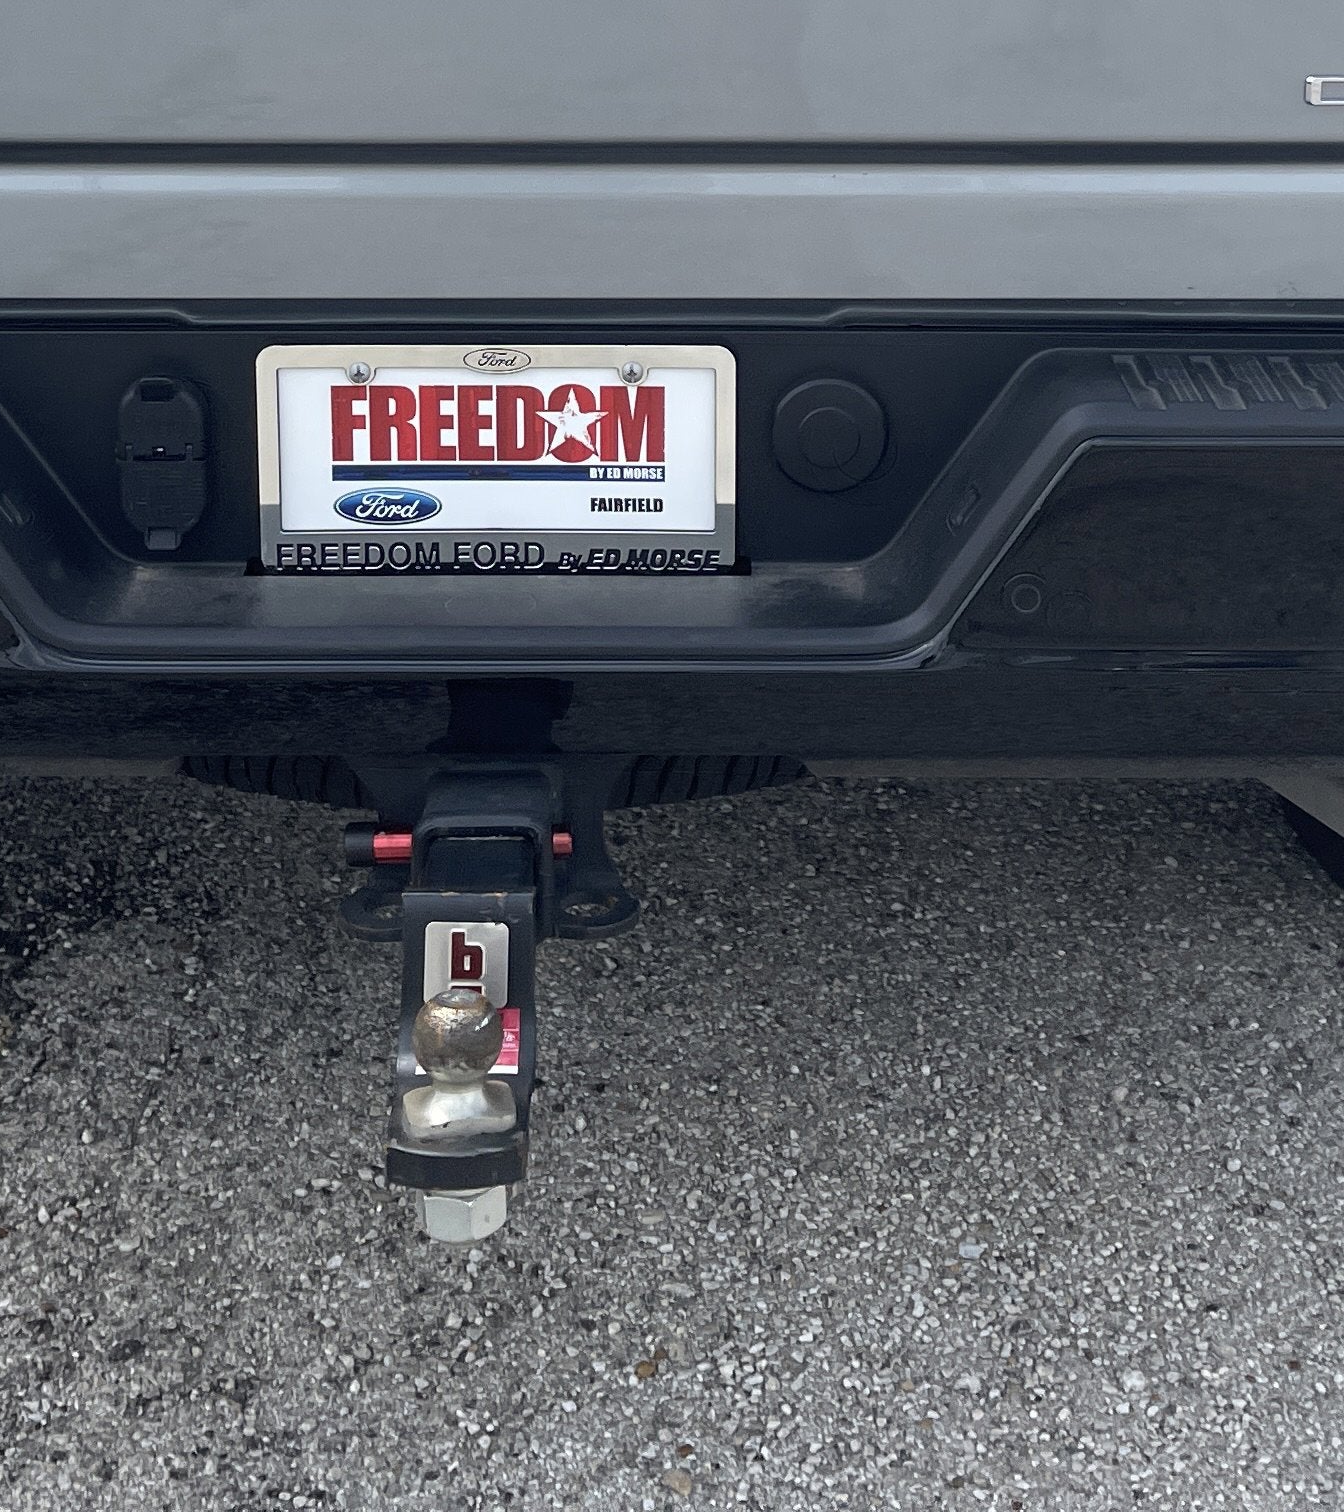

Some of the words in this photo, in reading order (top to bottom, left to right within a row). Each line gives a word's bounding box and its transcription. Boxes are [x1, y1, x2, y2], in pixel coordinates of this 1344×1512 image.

[477, 350, 518, 369] Ford
[330, 383, 666, 464] FREEDOM
[589, 467, 605, 480] BY
[606, 467, 621, 480] ED
[623, 467, 664, 480] MORSE
[353, 491, 420, 520] Ford
[590, 496, 664, 514] FAIRFIELD
[275, 541, 442, 572] FREEDOM
[452, 541, 546, 571] FORD
[585, 549, 626, 571] ED
[626, 548, 722, 572] MORSE
